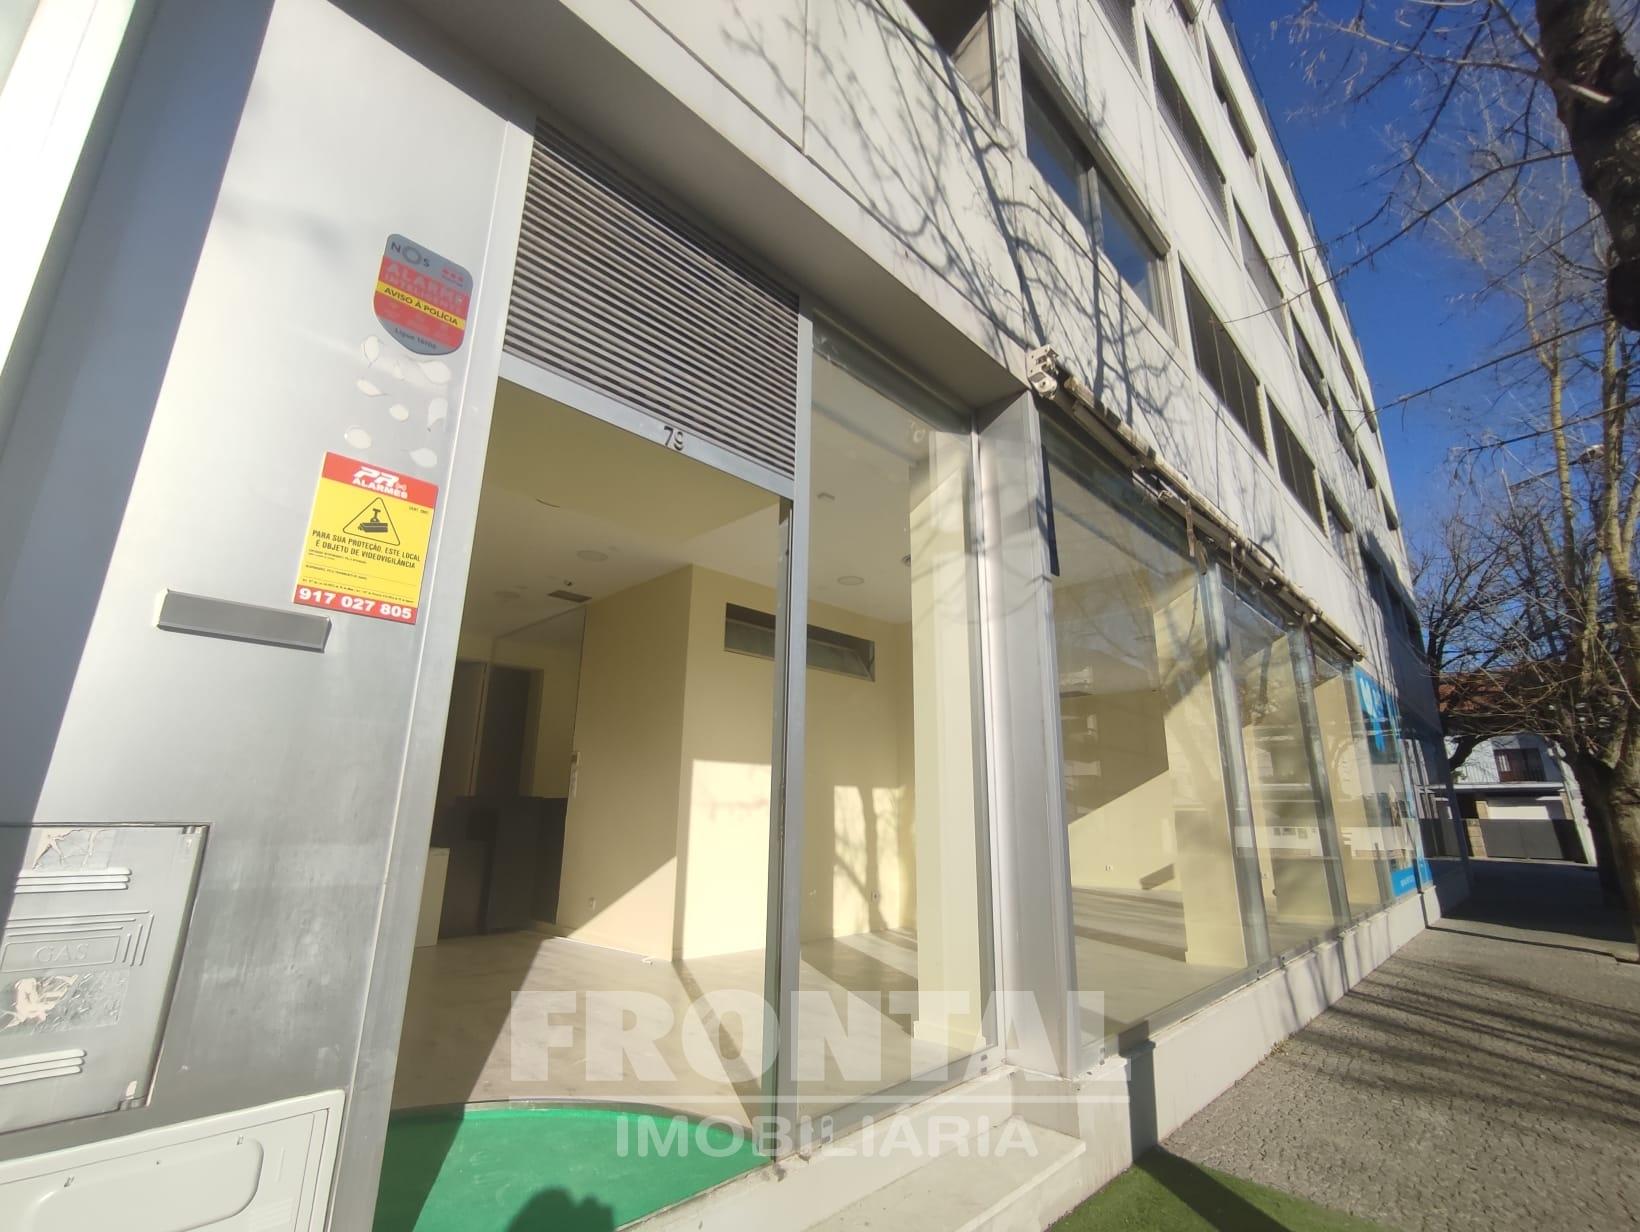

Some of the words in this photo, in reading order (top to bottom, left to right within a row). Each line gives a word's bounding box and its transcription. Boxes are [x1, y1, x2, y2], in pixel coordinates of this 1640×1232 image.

[390, 241, 430, 267] NOS
[384, 287, 413, 305] AVISO
[423, 305, 458, 325] POLÍCIA
[664, 425, 684, 451] 79
[352, 478, 408, 499] ALARMES
[312, 529, 332, 541] PARA
[332, 534, 347, 543] SUA
[384, 546, 401, 557] ESTE
[401, 550, 421, 562] LOCAL
[322, 541, 349, 554] OBJETO
[351, 547, 360, 556] DE
[361, 550, 416, 569] VIDEOVIGILÂNCIA
[299, 588, 336, 604] 917
[341, 596, 375, 612] 027
[380, 604, 412, 620] 805
[33, 942, 90, 966] GAS
